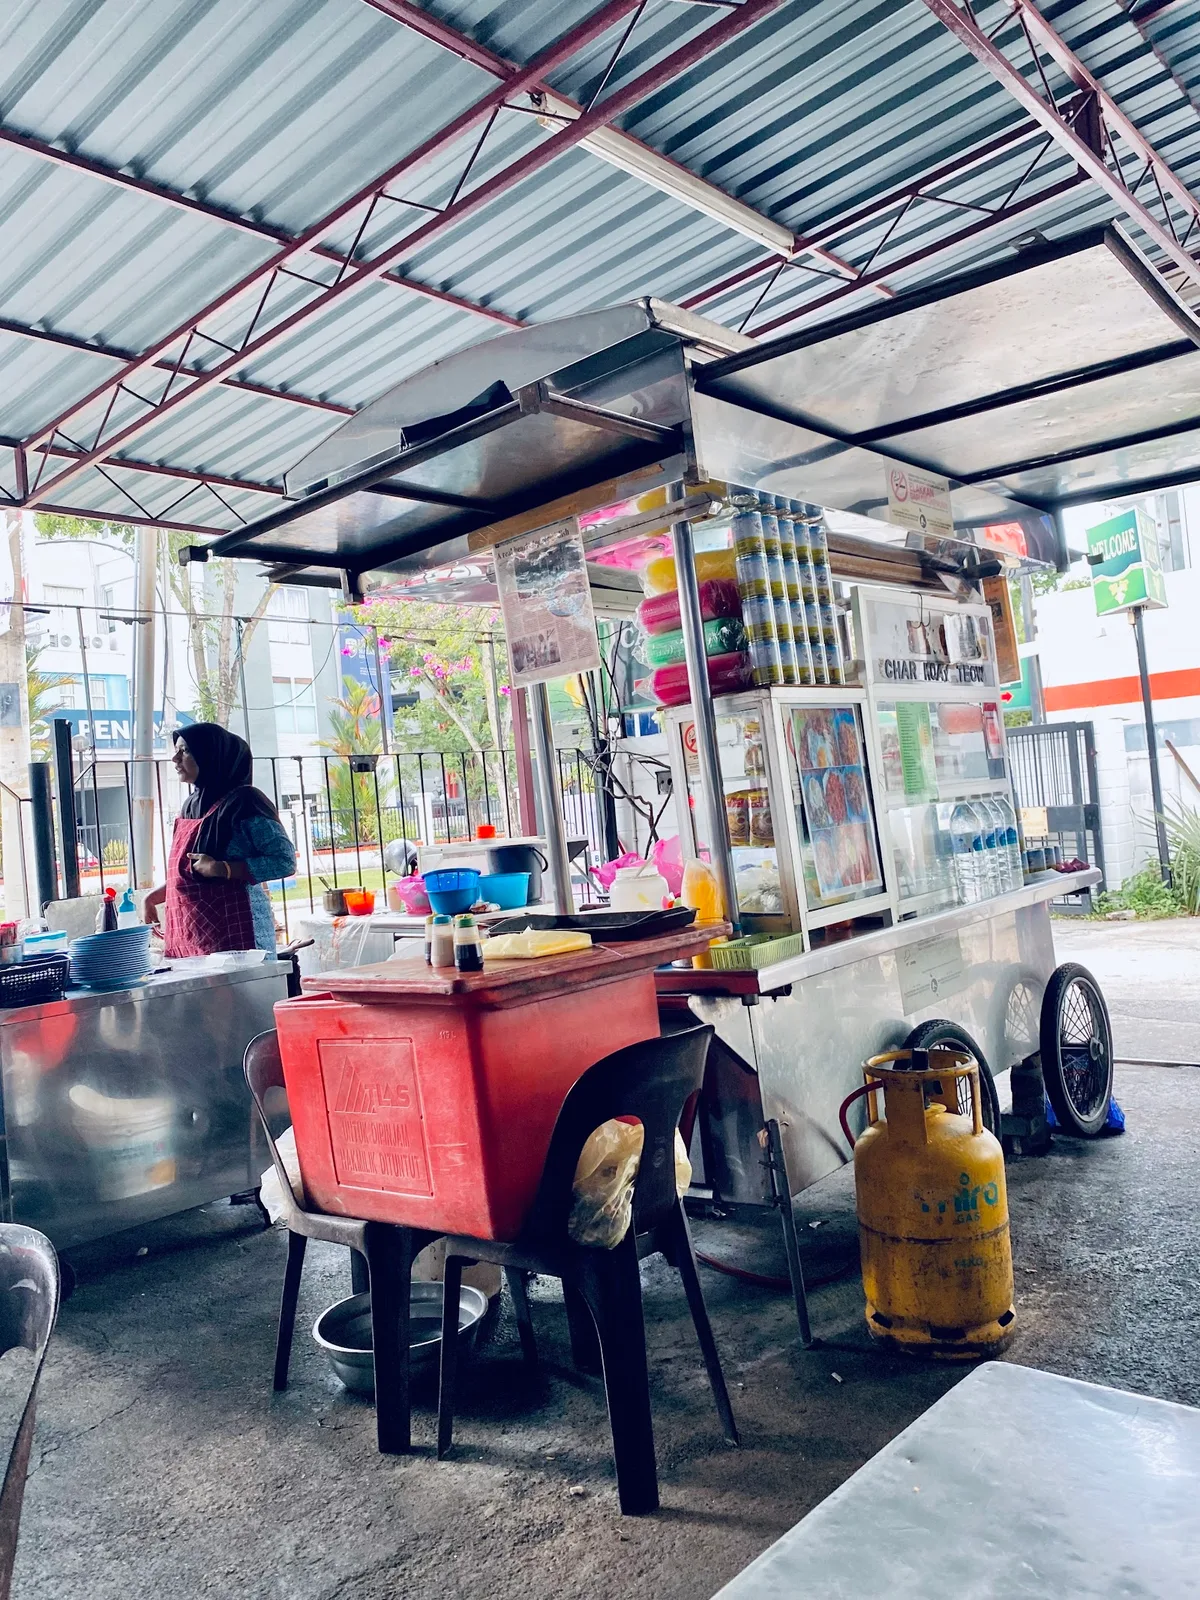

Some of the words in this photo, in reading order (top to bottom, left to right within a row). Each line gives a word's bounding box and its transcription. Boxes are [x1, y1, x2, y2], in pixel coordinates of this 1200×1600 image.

[1091, 528, 1137, 561] WELCOME
[884, 659, 917, 680] CHAR
[956, 664, 984, 683] TEOW
[335, 1055, 411, 1114] ATLAS
[957, 1212, 980, 1224] GAS
